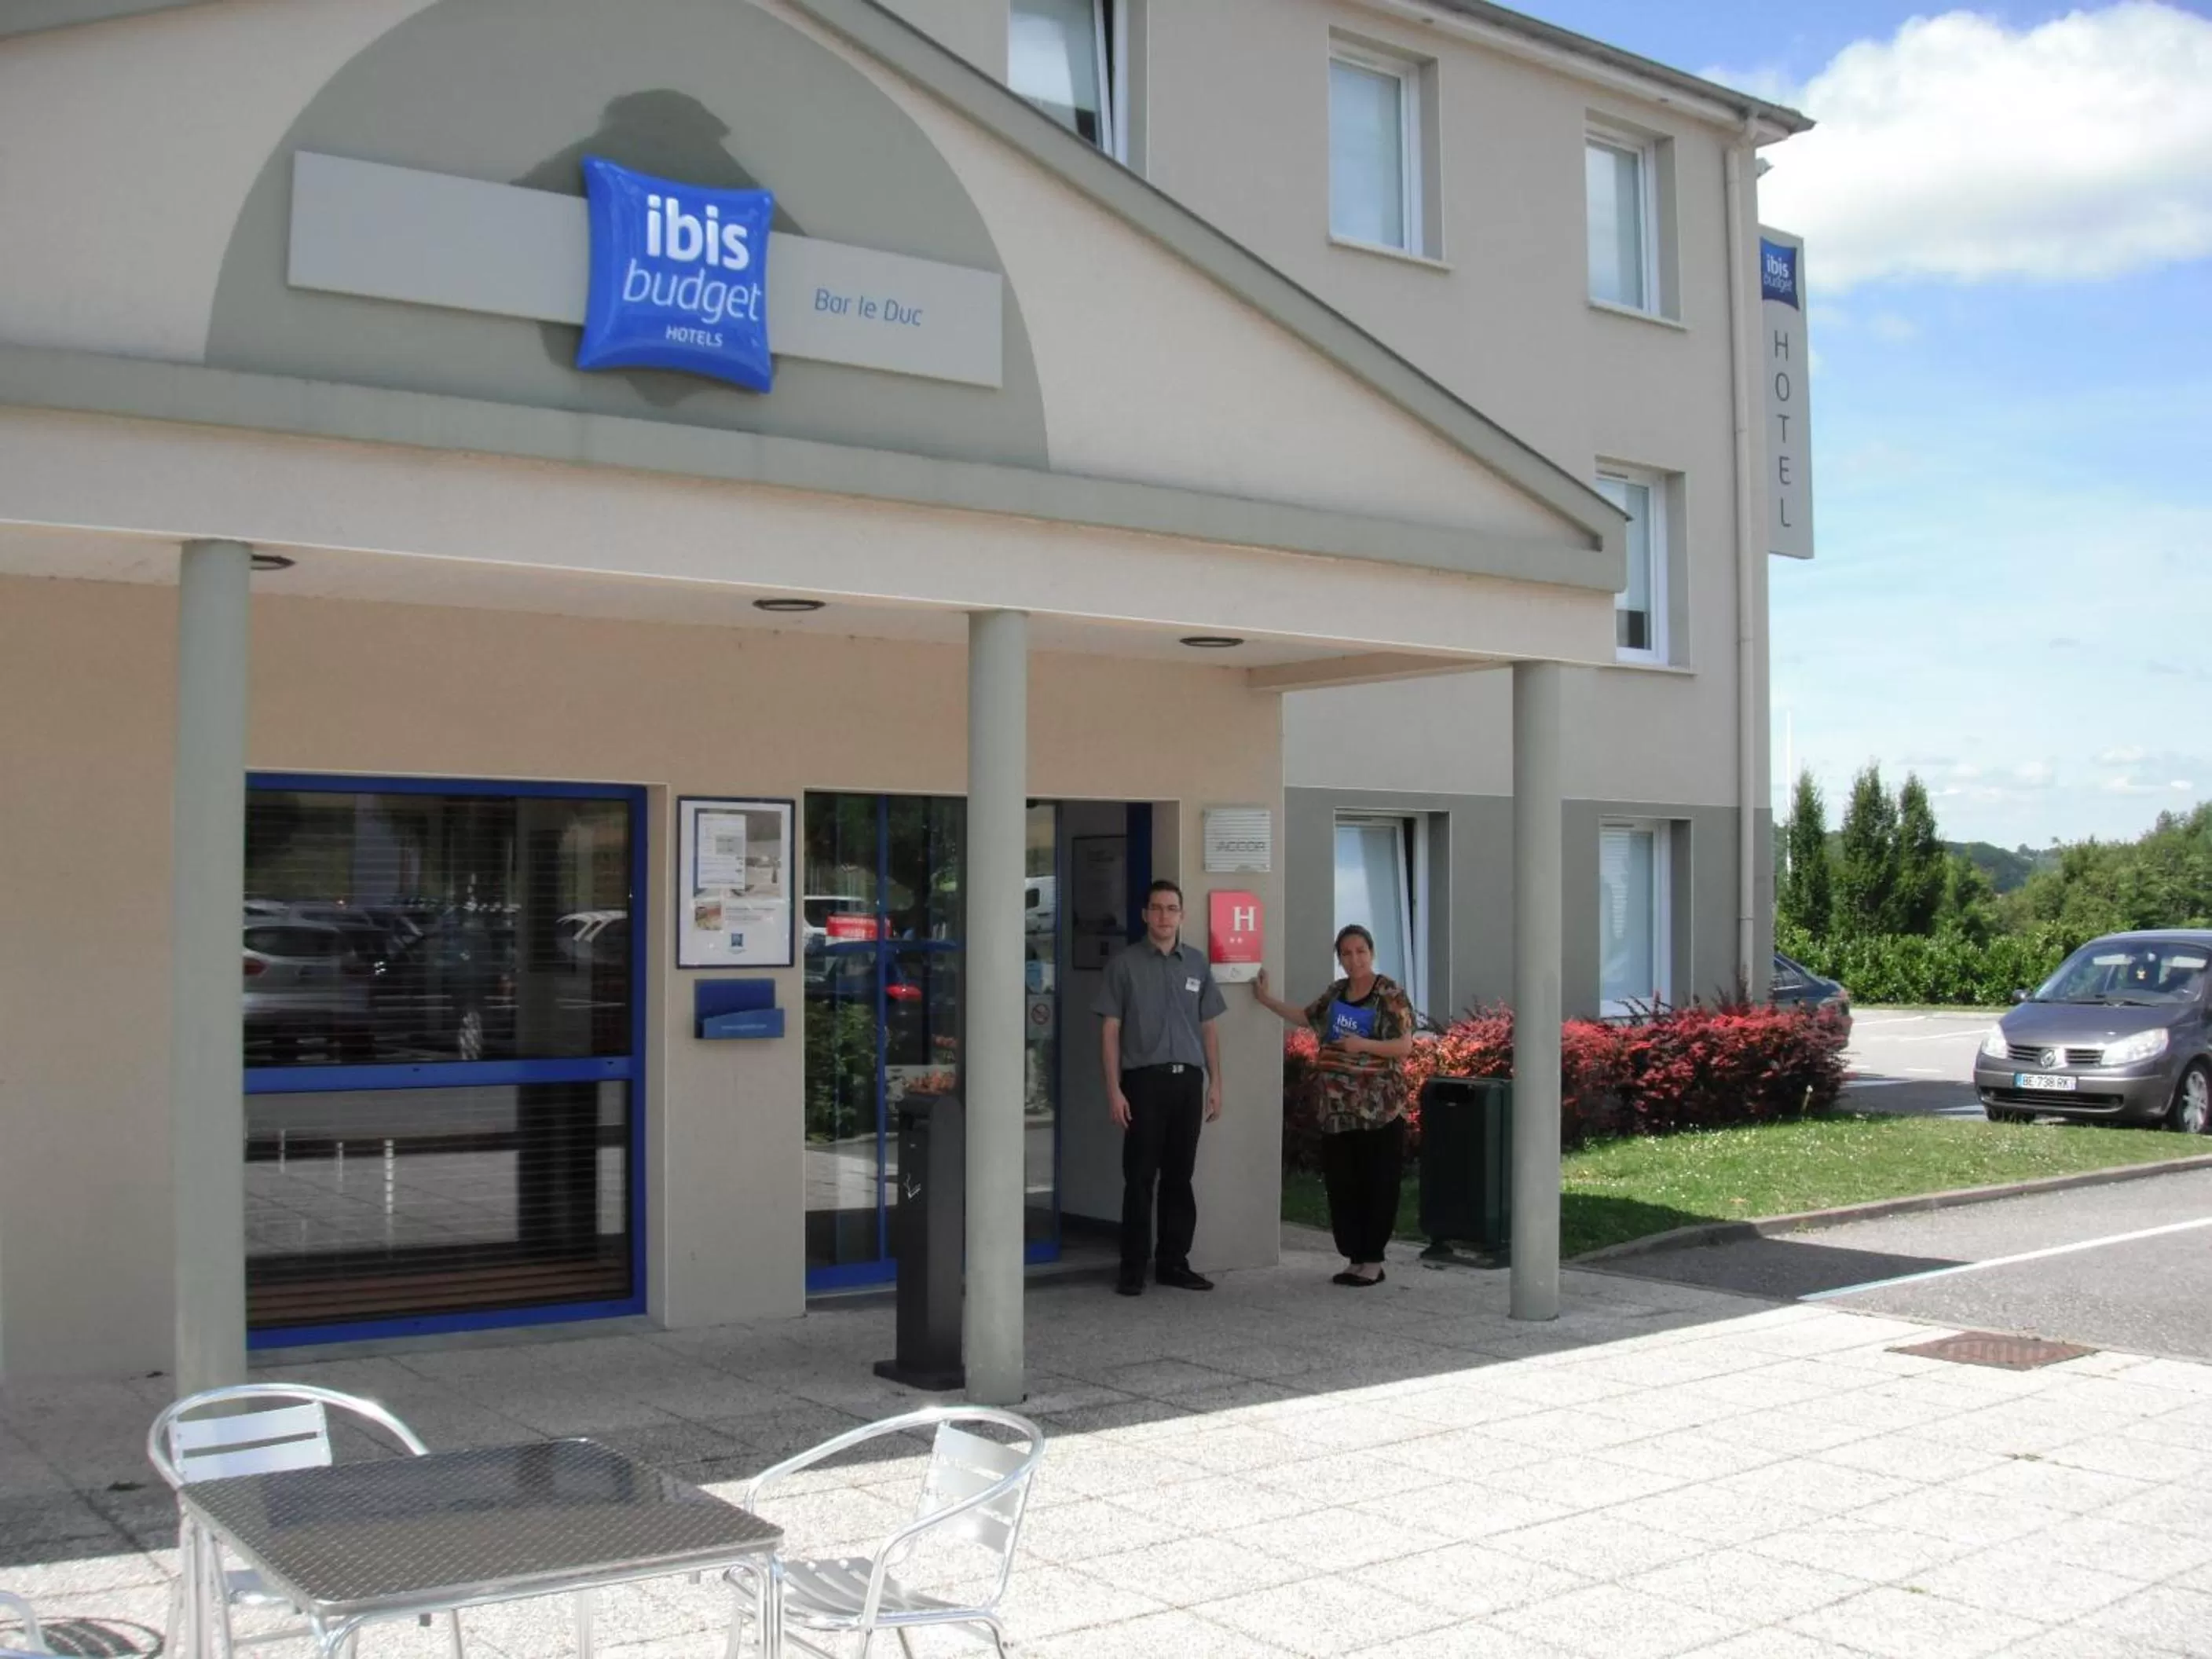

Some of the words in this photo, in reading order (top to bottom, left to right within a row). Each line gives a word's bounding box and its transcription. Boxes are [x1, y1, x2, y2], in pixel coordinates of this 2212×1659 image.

[646, 194, 750, 270] ibis
[1766, 254, 1789, 278] ibis
[623, 258, 761, 324] budget
[815, 287, 852, 314] Bar
[859, 295, 877, 319] le
[884, 298, 924, 327] Duc
[665, 324, 723, 346] HOTELS
[1774, 329, 1792, 528] HOTEL
[1232, 906, 1257, 932] H
[1337, 1013, 1357, 1031] ibis
